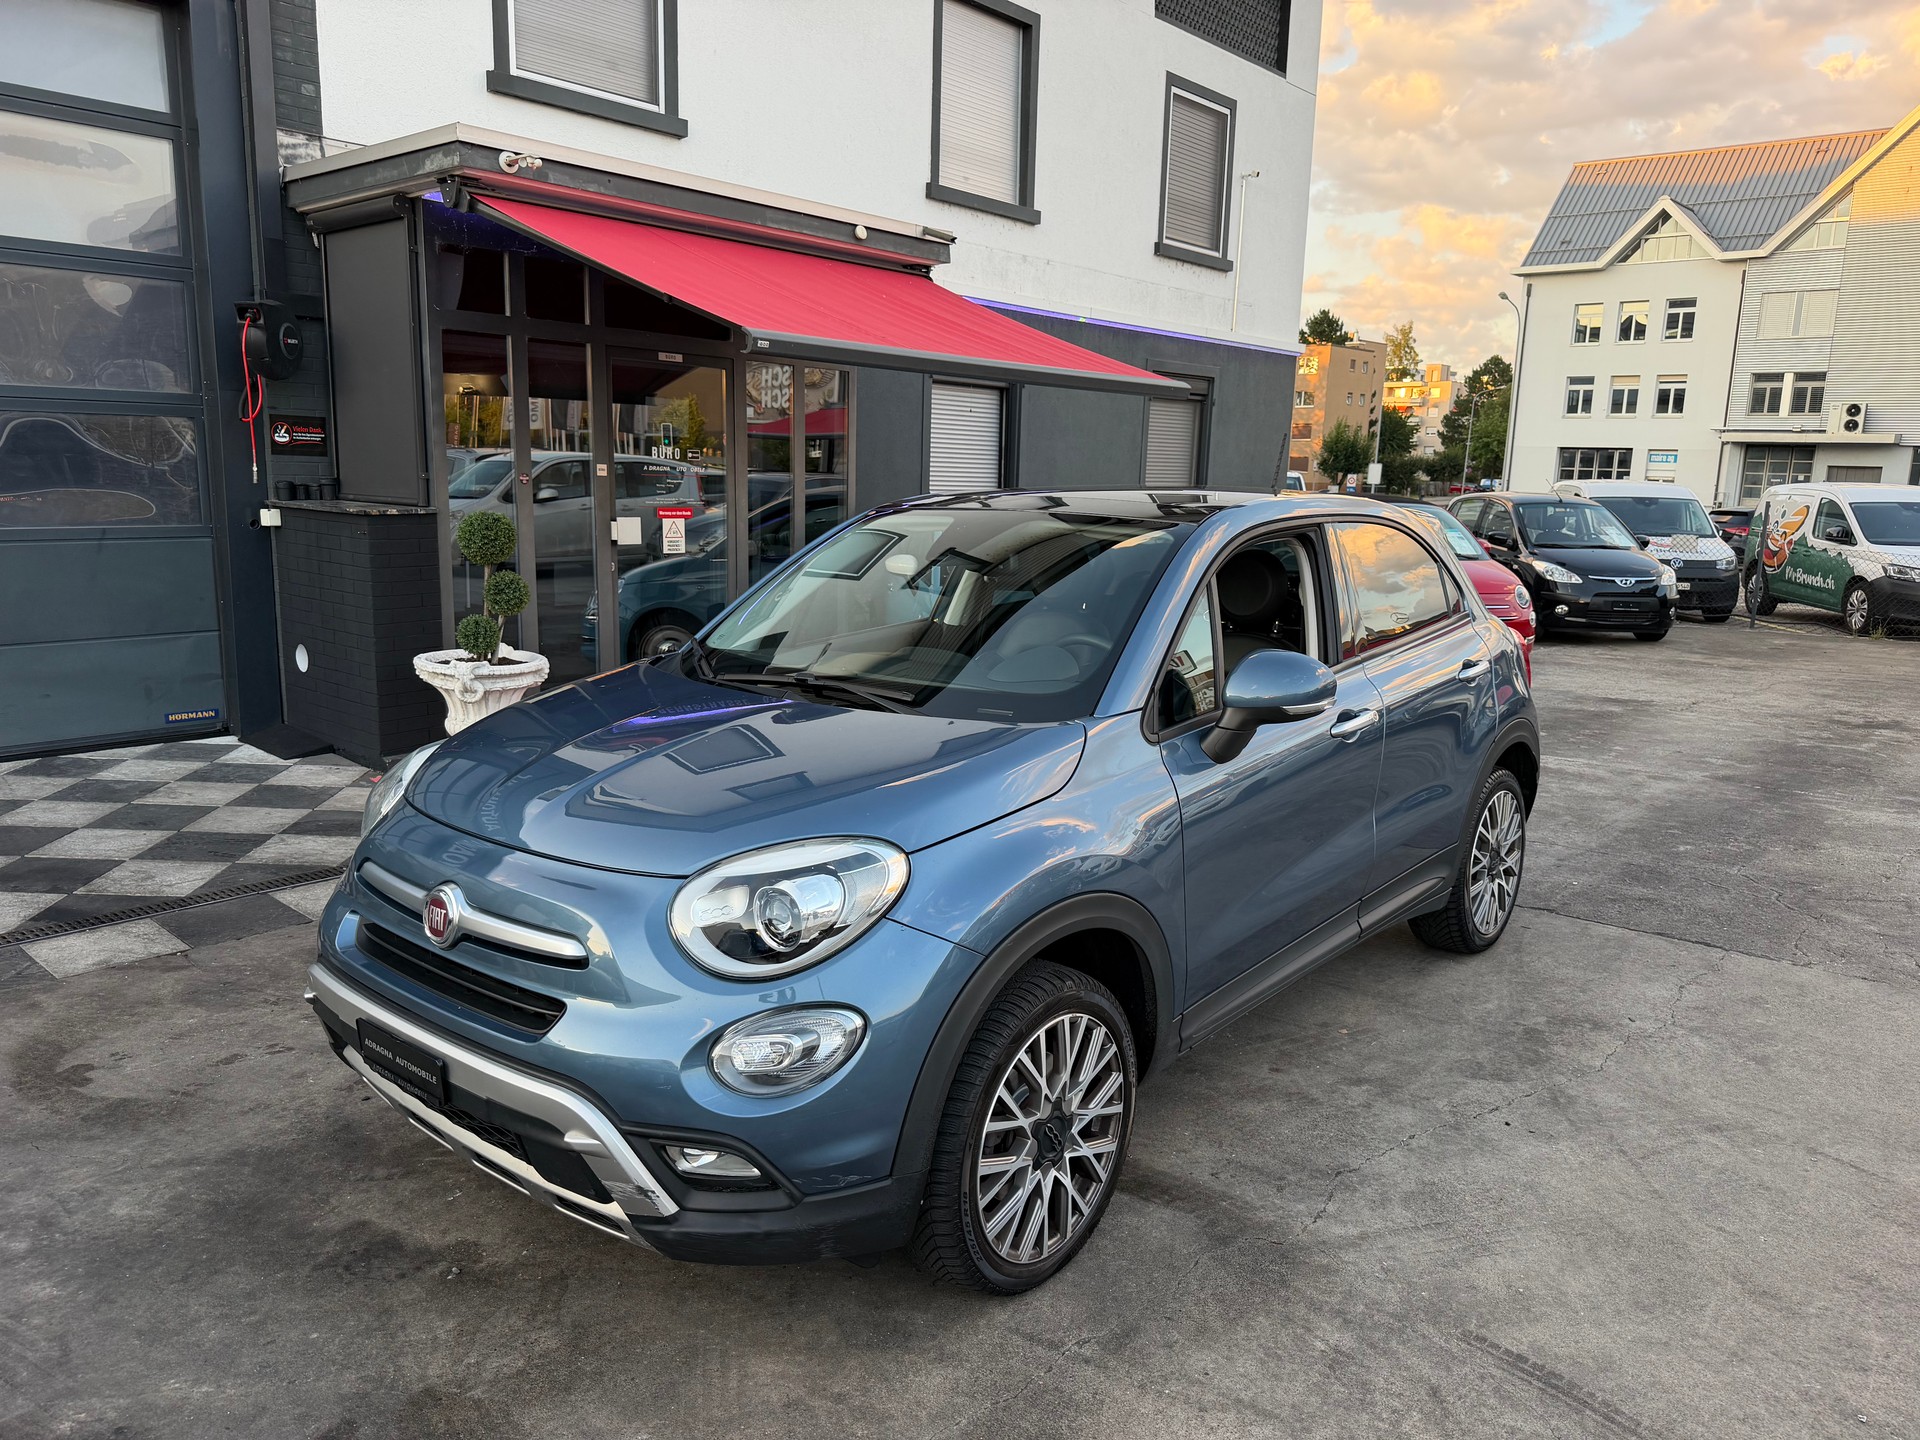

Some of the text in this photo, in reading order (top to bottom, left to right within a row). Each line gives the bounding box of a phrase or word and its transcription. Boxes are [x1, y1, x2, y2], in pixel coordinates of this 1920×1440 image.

[651, 445, 681, 460] BÜRO
[429, 904, 447, 932] FIAT
[364, 1037, 438, 1085] ADRAGNA AUTOMOBILE
